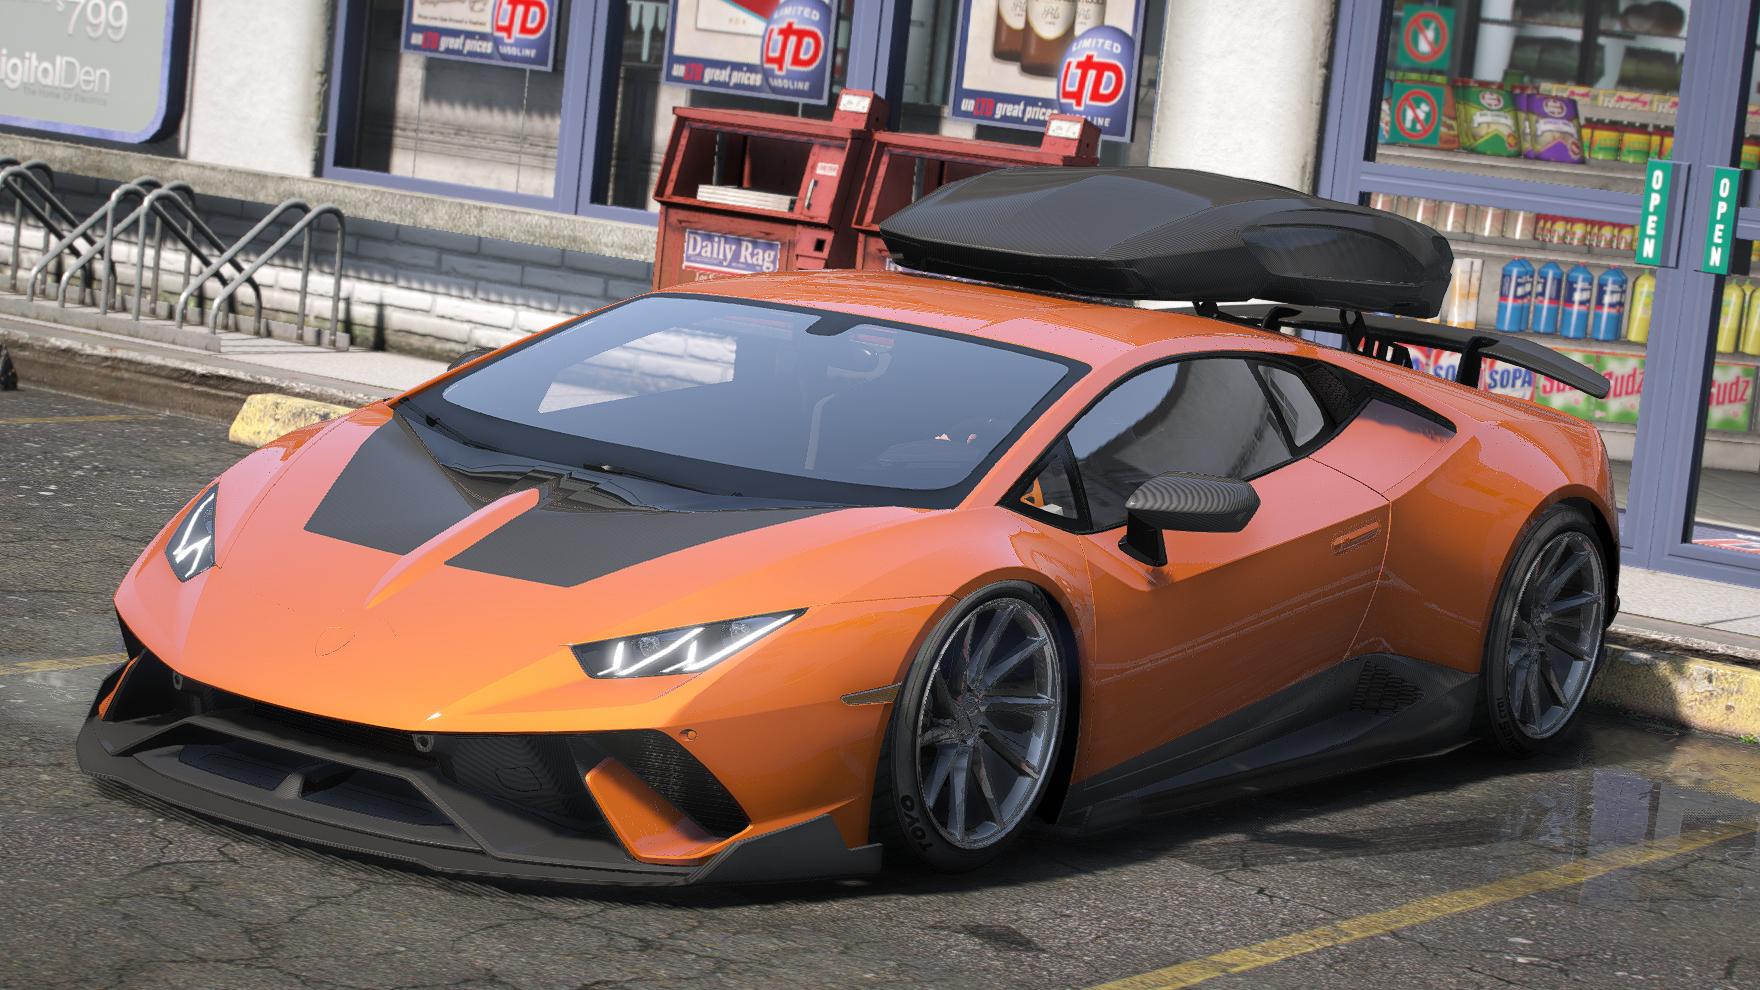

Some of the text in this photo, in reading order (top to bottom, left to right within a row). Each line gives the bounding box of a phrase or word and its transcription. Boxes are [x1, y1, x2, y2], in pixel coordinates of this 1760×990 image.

[493, 0, 549, 43] LTD
[774, 6, 820, 21] LIMITED
[438, 34, 465, 52] great
[463, 35, 494, 54] prices
[763, 20, 824, 74] LTD
[1071, 38, 1121, 53] LIMITED
[703, 65, 731, 86] great
[730, 66, 762, 86] prices
[1060, 52, 1125, 110] LTD
[994, 101, 1026, 119] great
[1642, 169, 1664, 259] OPEN
[1709, 178, 1731, 267] OPEN
[687, 234, 777, 272] Daily Rag
[1488, 368, 1533, 390] SOPA
[901, 795, 934, 852] TOYO
